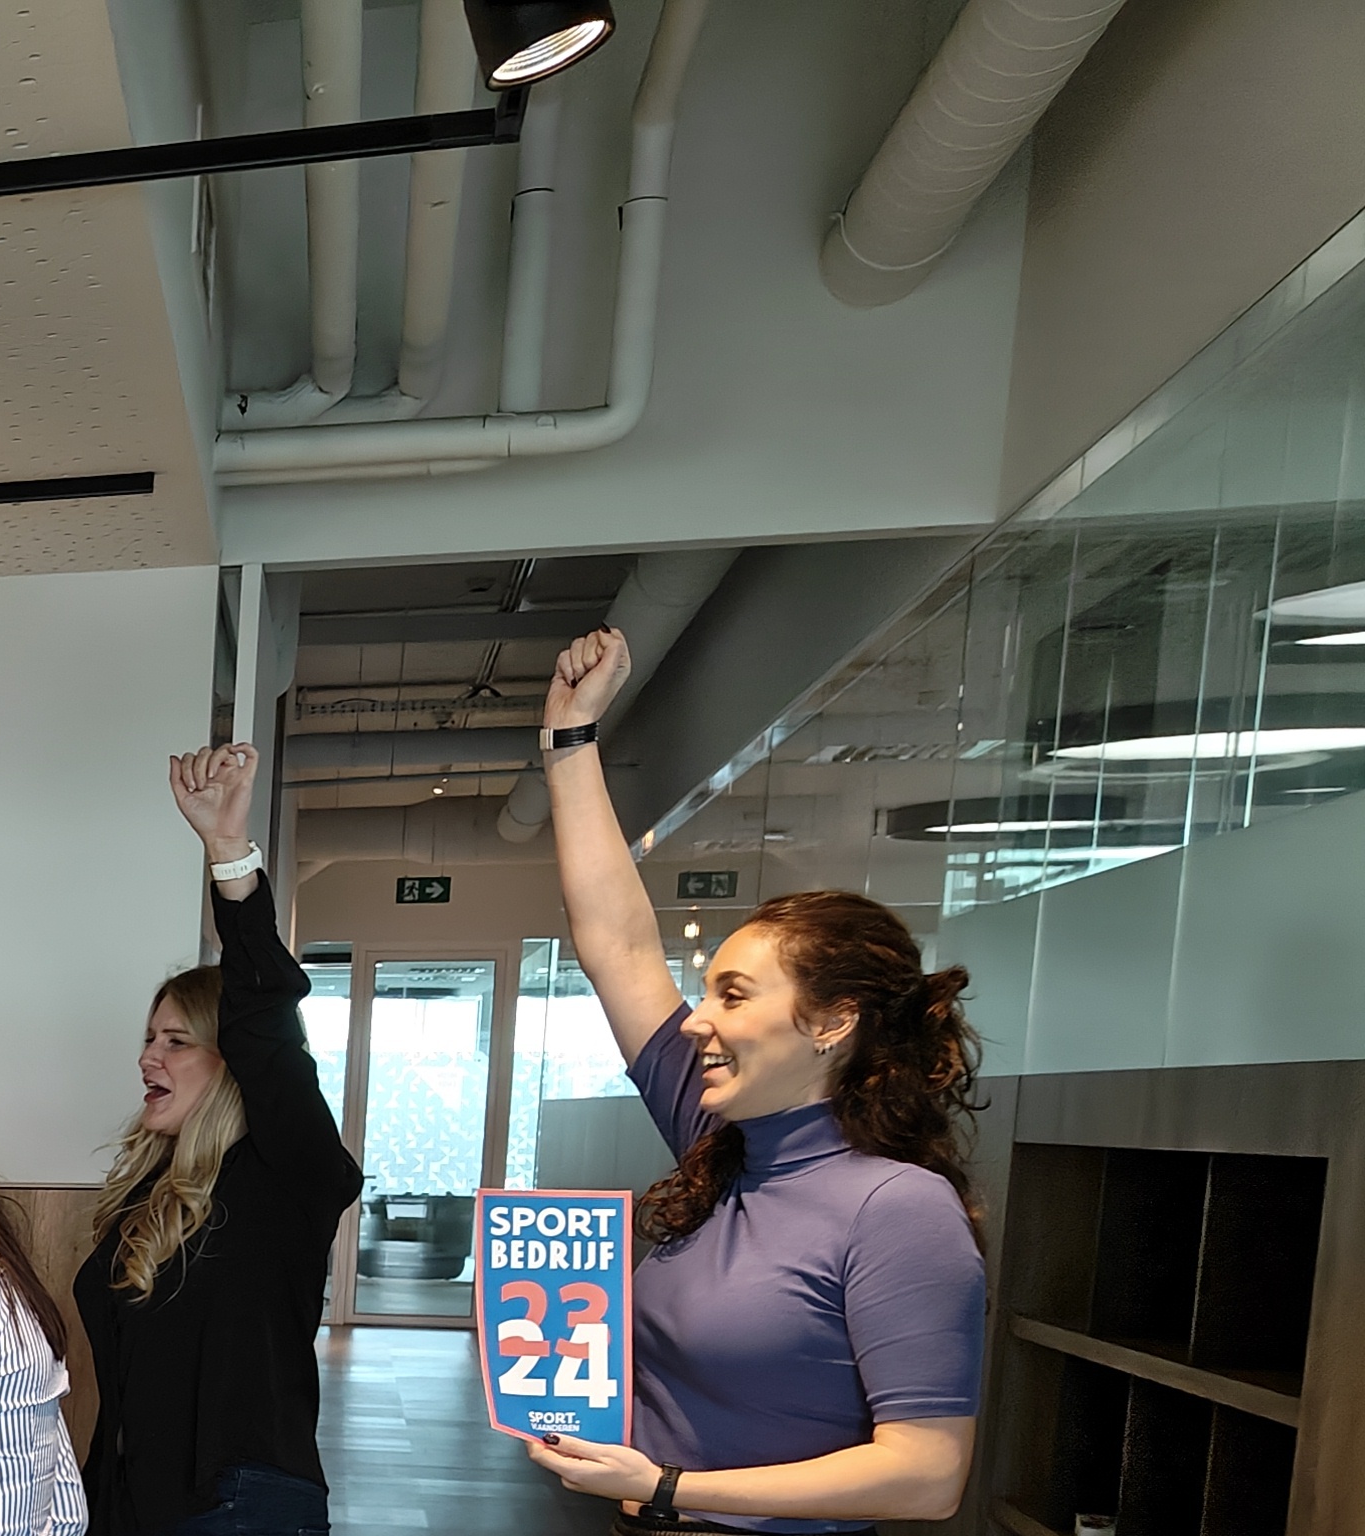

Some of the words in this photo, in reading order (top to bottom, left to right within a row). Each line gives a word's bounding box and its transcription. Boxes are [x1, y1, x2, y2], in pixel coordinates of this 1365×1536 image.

[489, 1206, 617, 1238] SPORT
[490, 1239, 615, 1271] BEDRIJF
[497, 1280, 612, 1359] 23
[497, 1318, 618, 1409] 24
[528, 1411, 581, 1424] SPORT.
